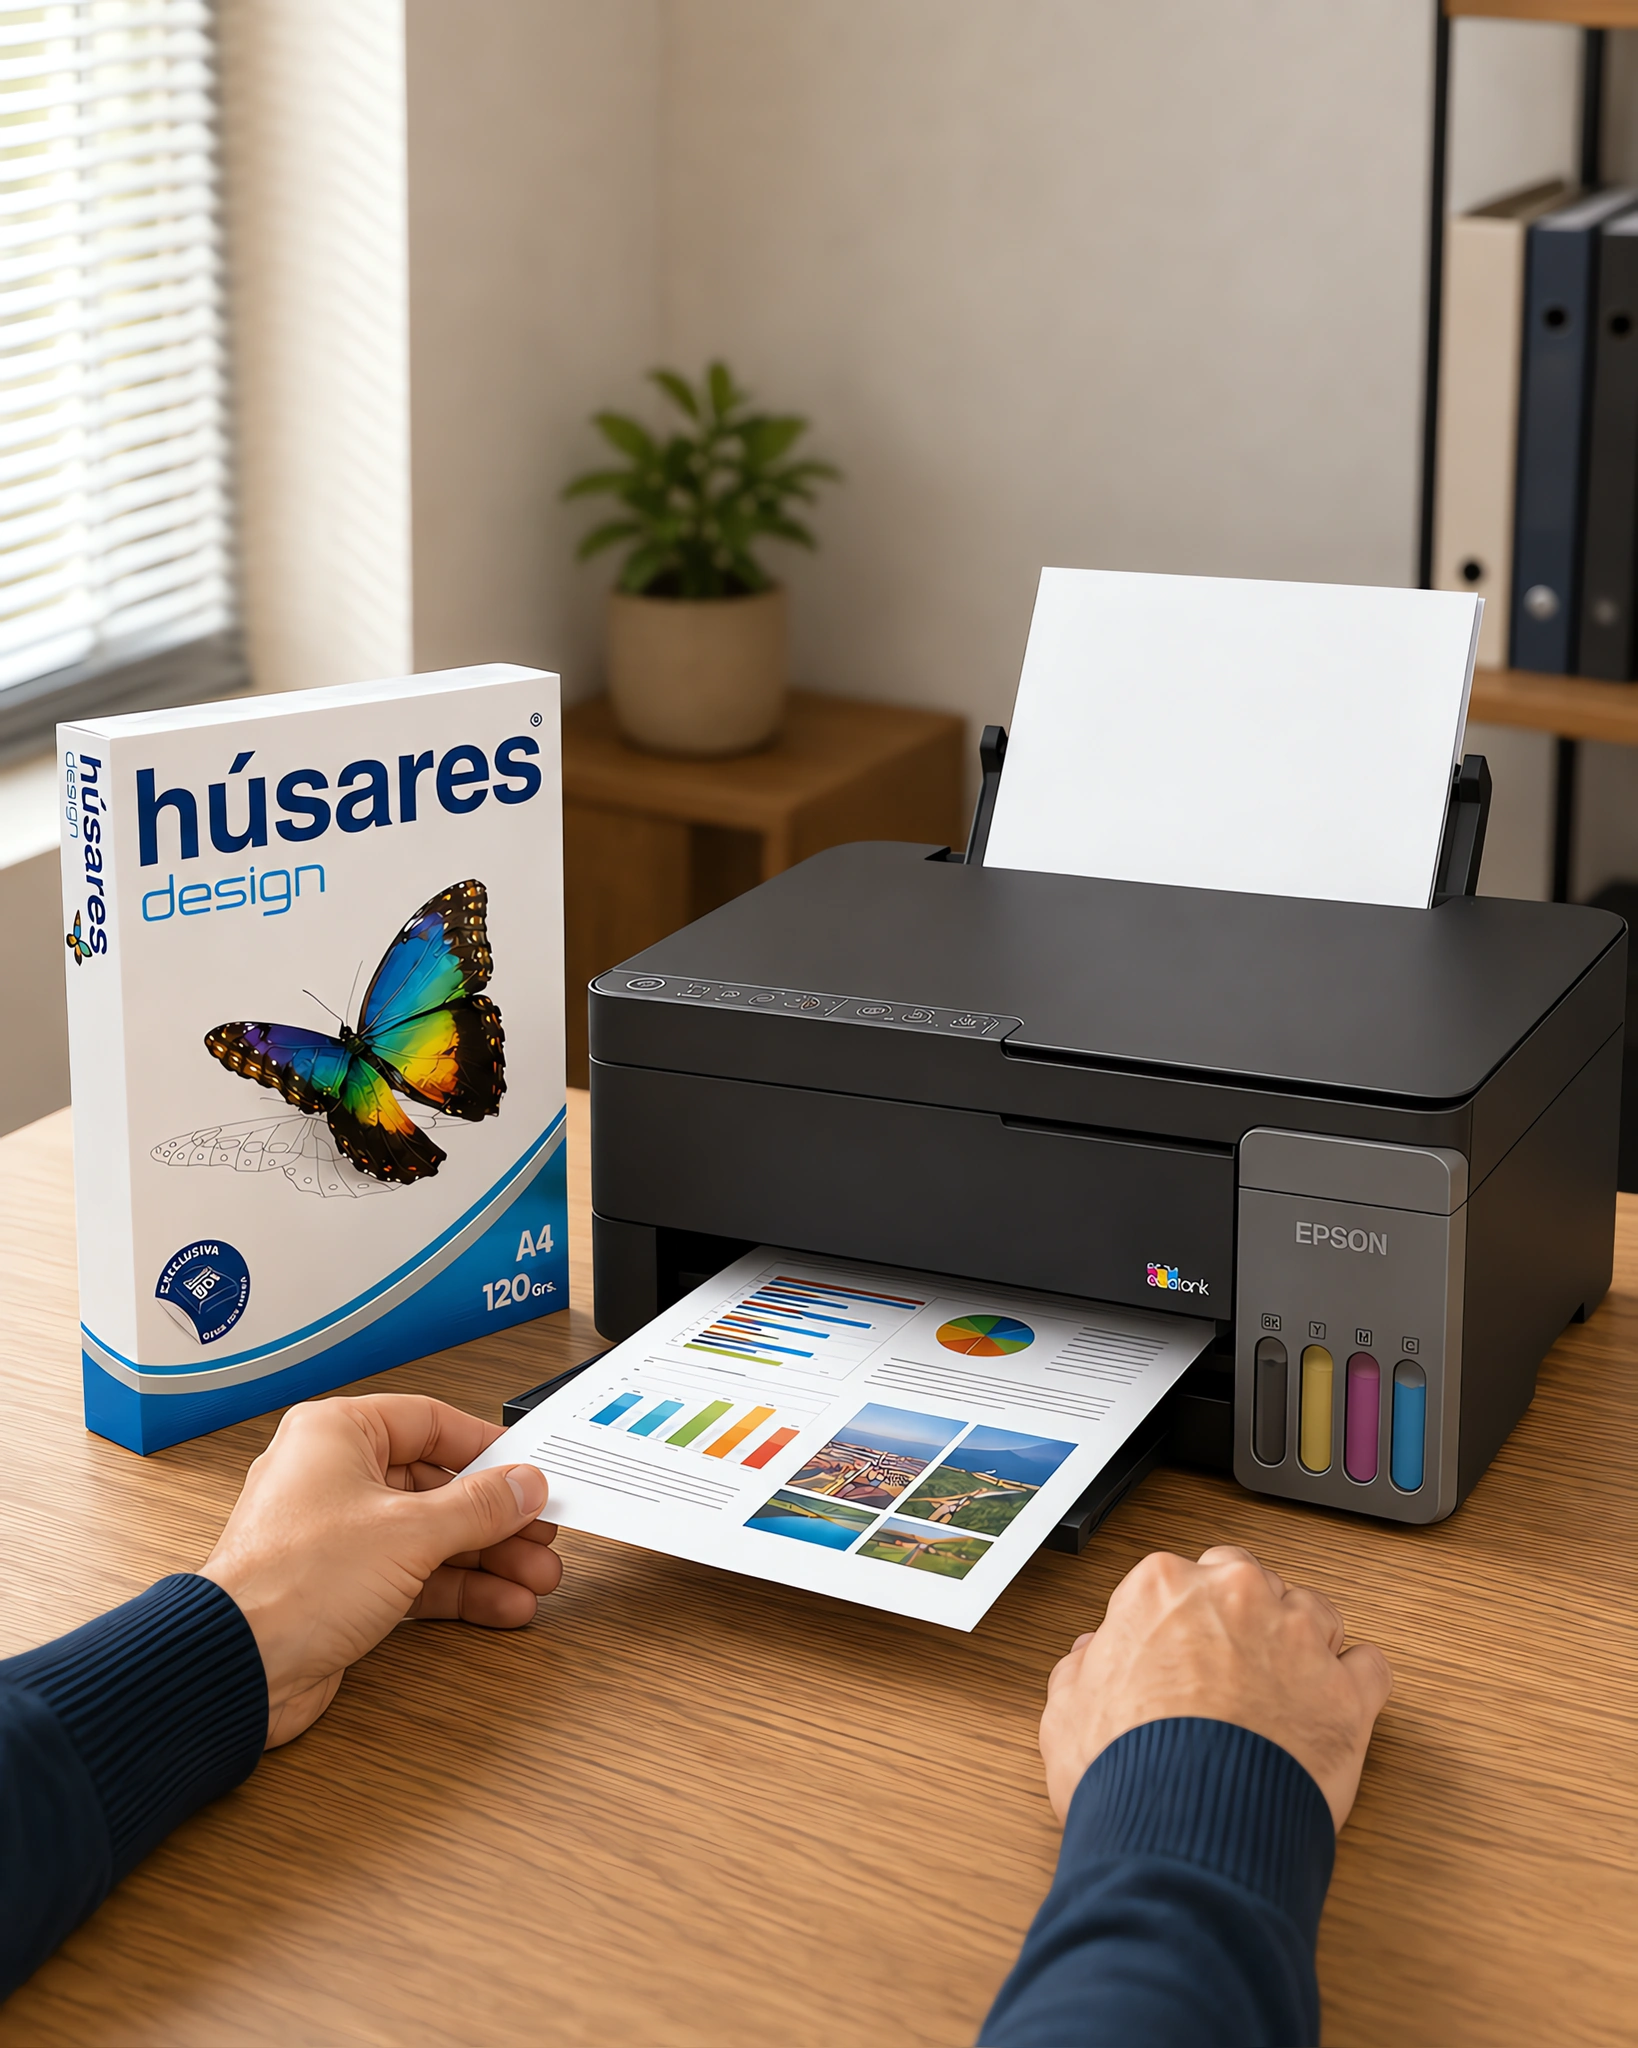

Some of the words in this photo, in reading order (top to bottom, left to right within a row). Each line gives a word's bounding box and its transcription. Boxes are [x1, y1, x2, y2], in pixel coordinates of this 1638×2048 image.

[65, 751, 79, 839] design
[135, 735, 543, 868] húsares
[79, 753, 108, 956] húsares
[140, 863, 326, 922] design
[515, 1224, 554, 1262] A4
[1295, 1221, 1388, 1256] EPSON
